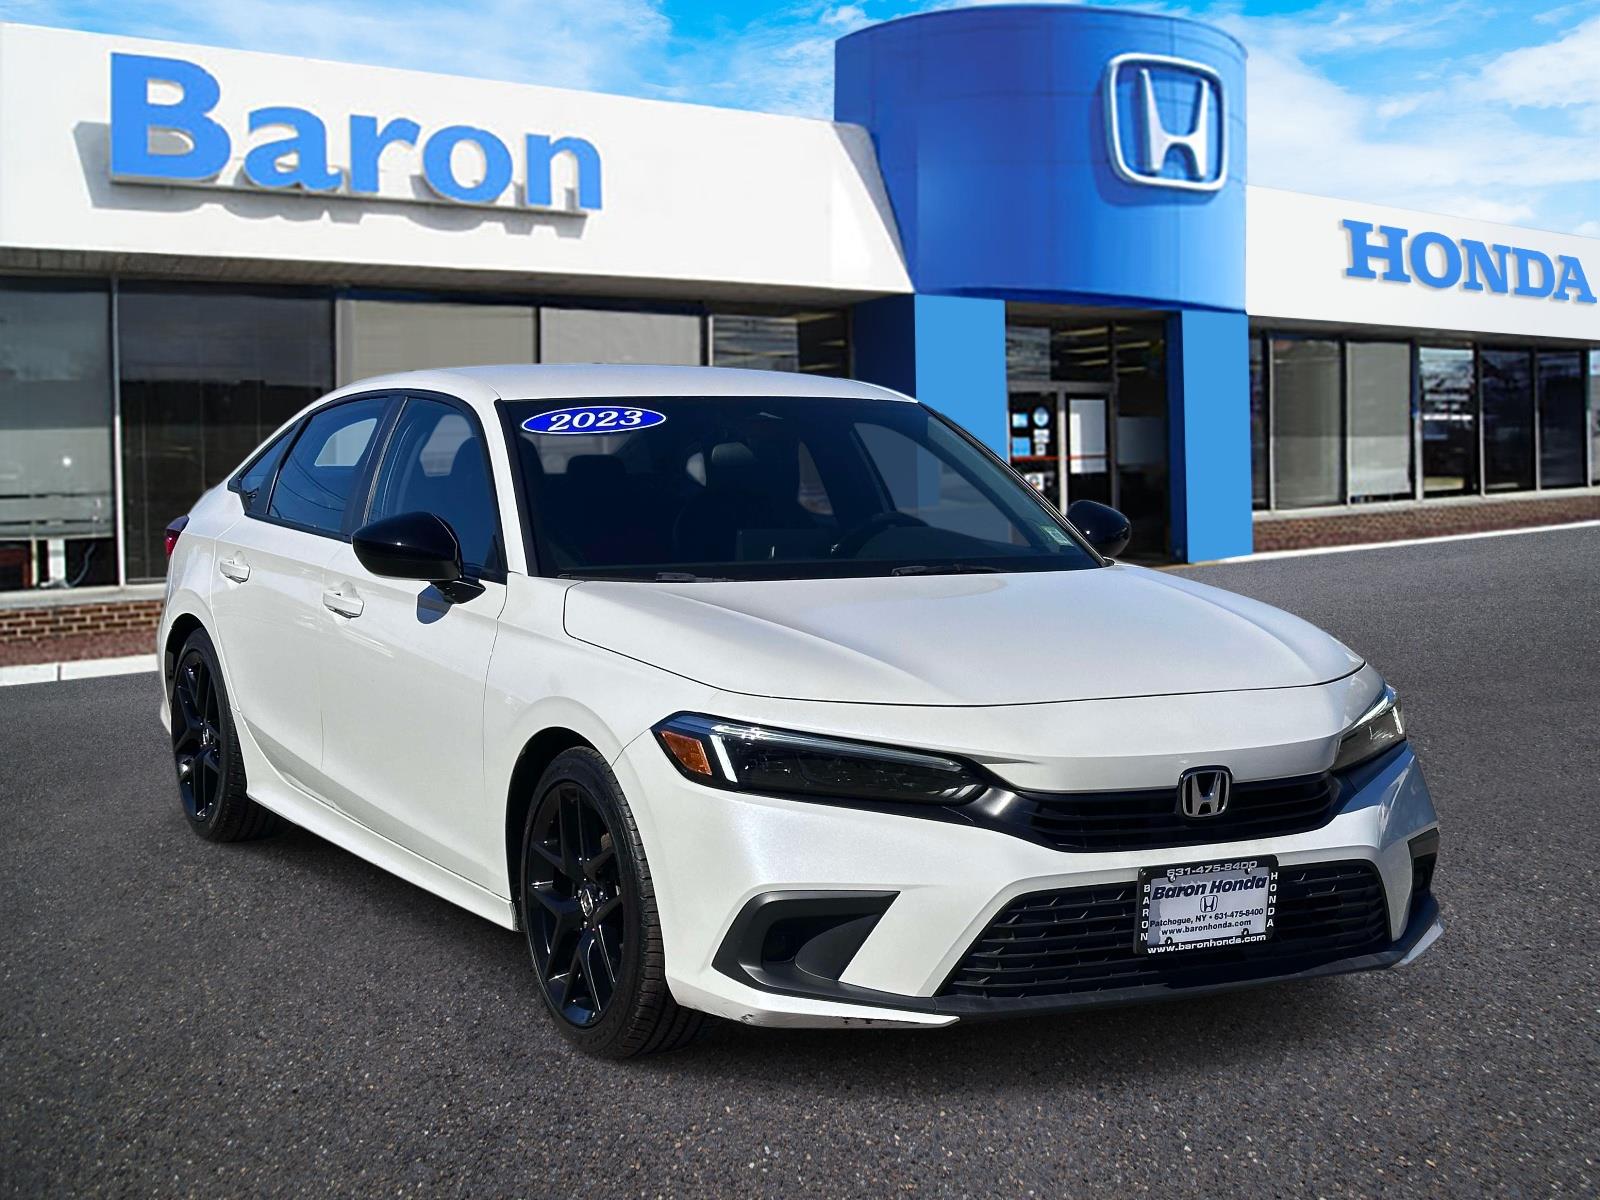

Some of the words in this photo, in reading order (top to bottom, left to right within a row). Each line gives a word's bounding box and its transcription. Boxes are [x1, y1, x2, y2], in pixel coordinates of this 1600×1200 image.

[109, 51, 603, 211] Baron
[1340, 218, 1598, 304] HONDA
[548, 411, 642, 431] 2023
[1152, 884, 1206, 900] Baron
[1209, 876, 1268, 893] Honda
[1266, 872, 1278, 927] HONDA
[1140, 884, 1151, 941] BARON
[1150, 917, 1194, 927] Patchogue,
[1195, 914, 1207, 922] NY
[1161, 920, 1251, 935] www.baronhonda.com
[1147, 935, 1266, 953] www.baronhonda.com
